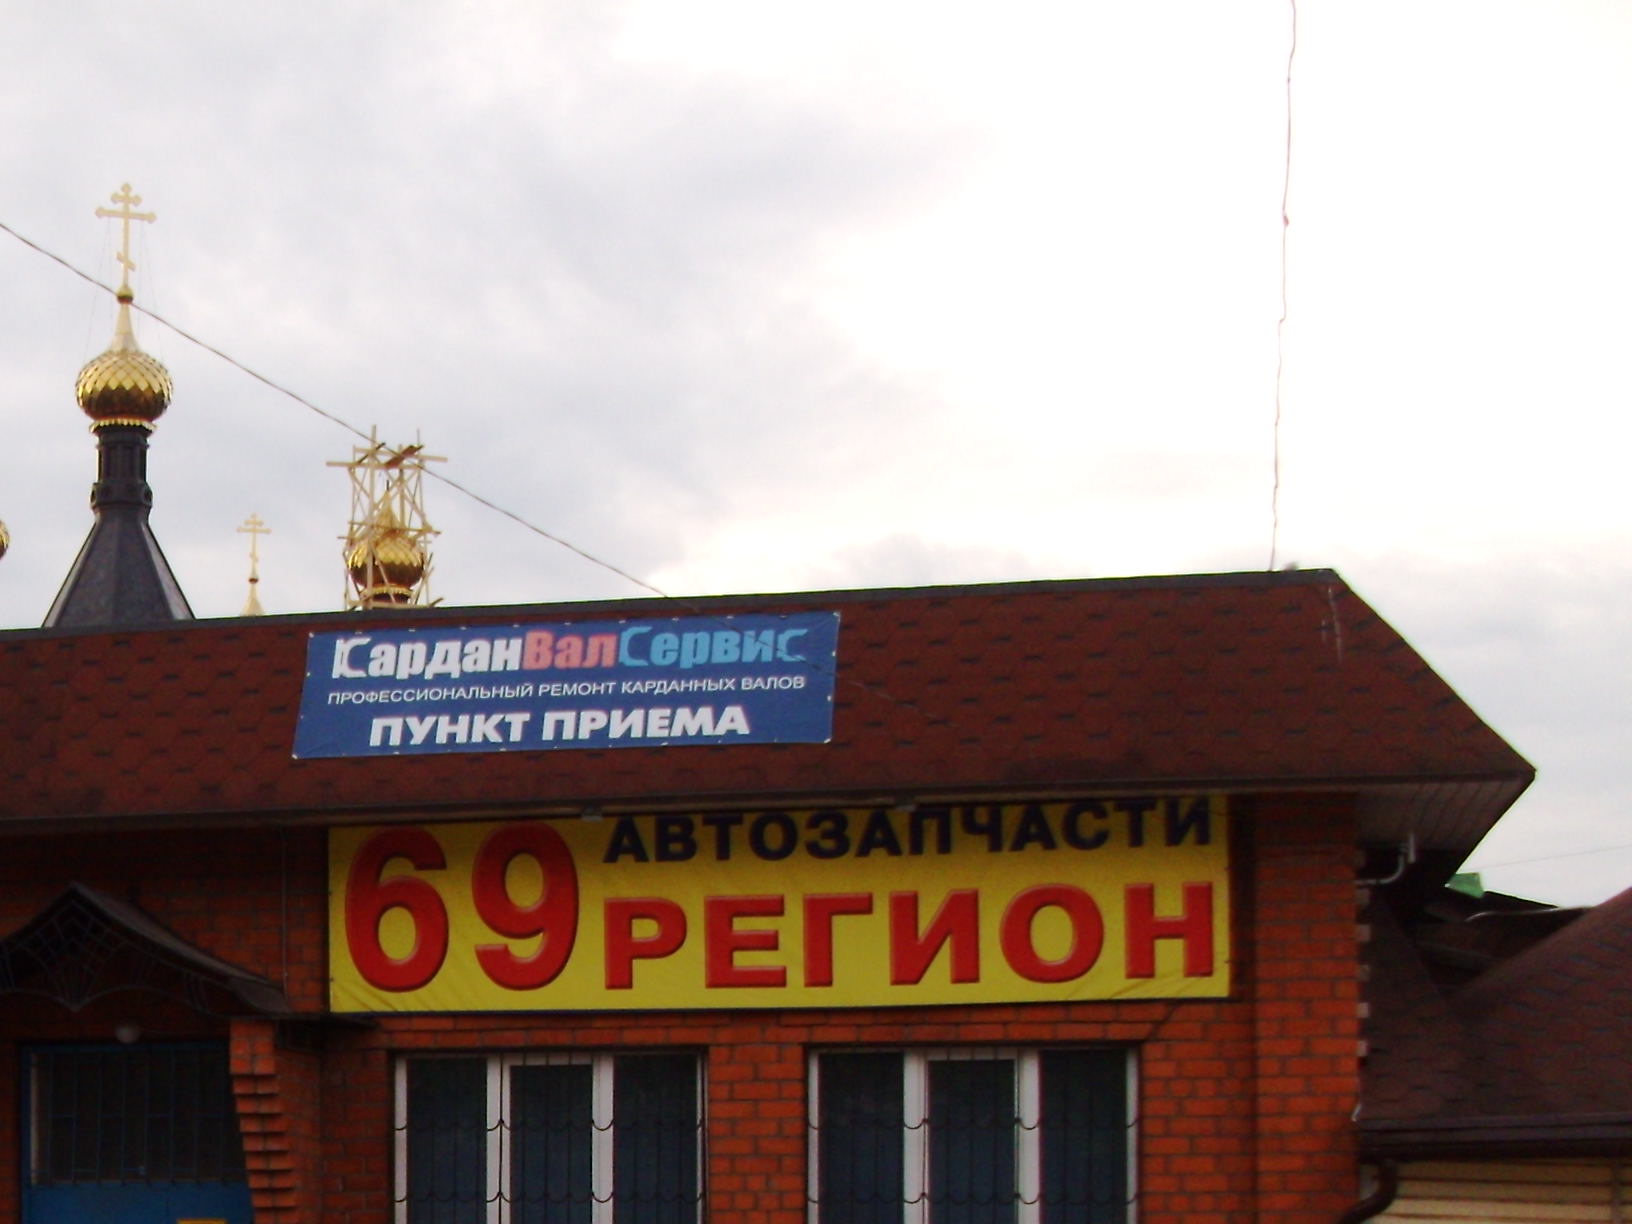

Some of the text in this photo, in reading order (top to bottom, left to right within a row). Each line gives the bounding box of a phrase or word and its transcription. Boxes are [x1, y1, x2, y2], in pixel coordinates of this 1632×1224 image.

[332, 626, 808, 680] КарданВалСервис
[328, 676, 805, 705] ПРОФЕССИОНАЛЬНЫЙ РЕМОНТ КАРДАННЫХ ВАЛОВ
[369, 705, 750, 746] ПУНКТ ПРИЕМА
[602, 799, 1212, 863] АВТОЗАПЧАСТИ
[343, 823, 1215, 993] 69 РЕГИОН
